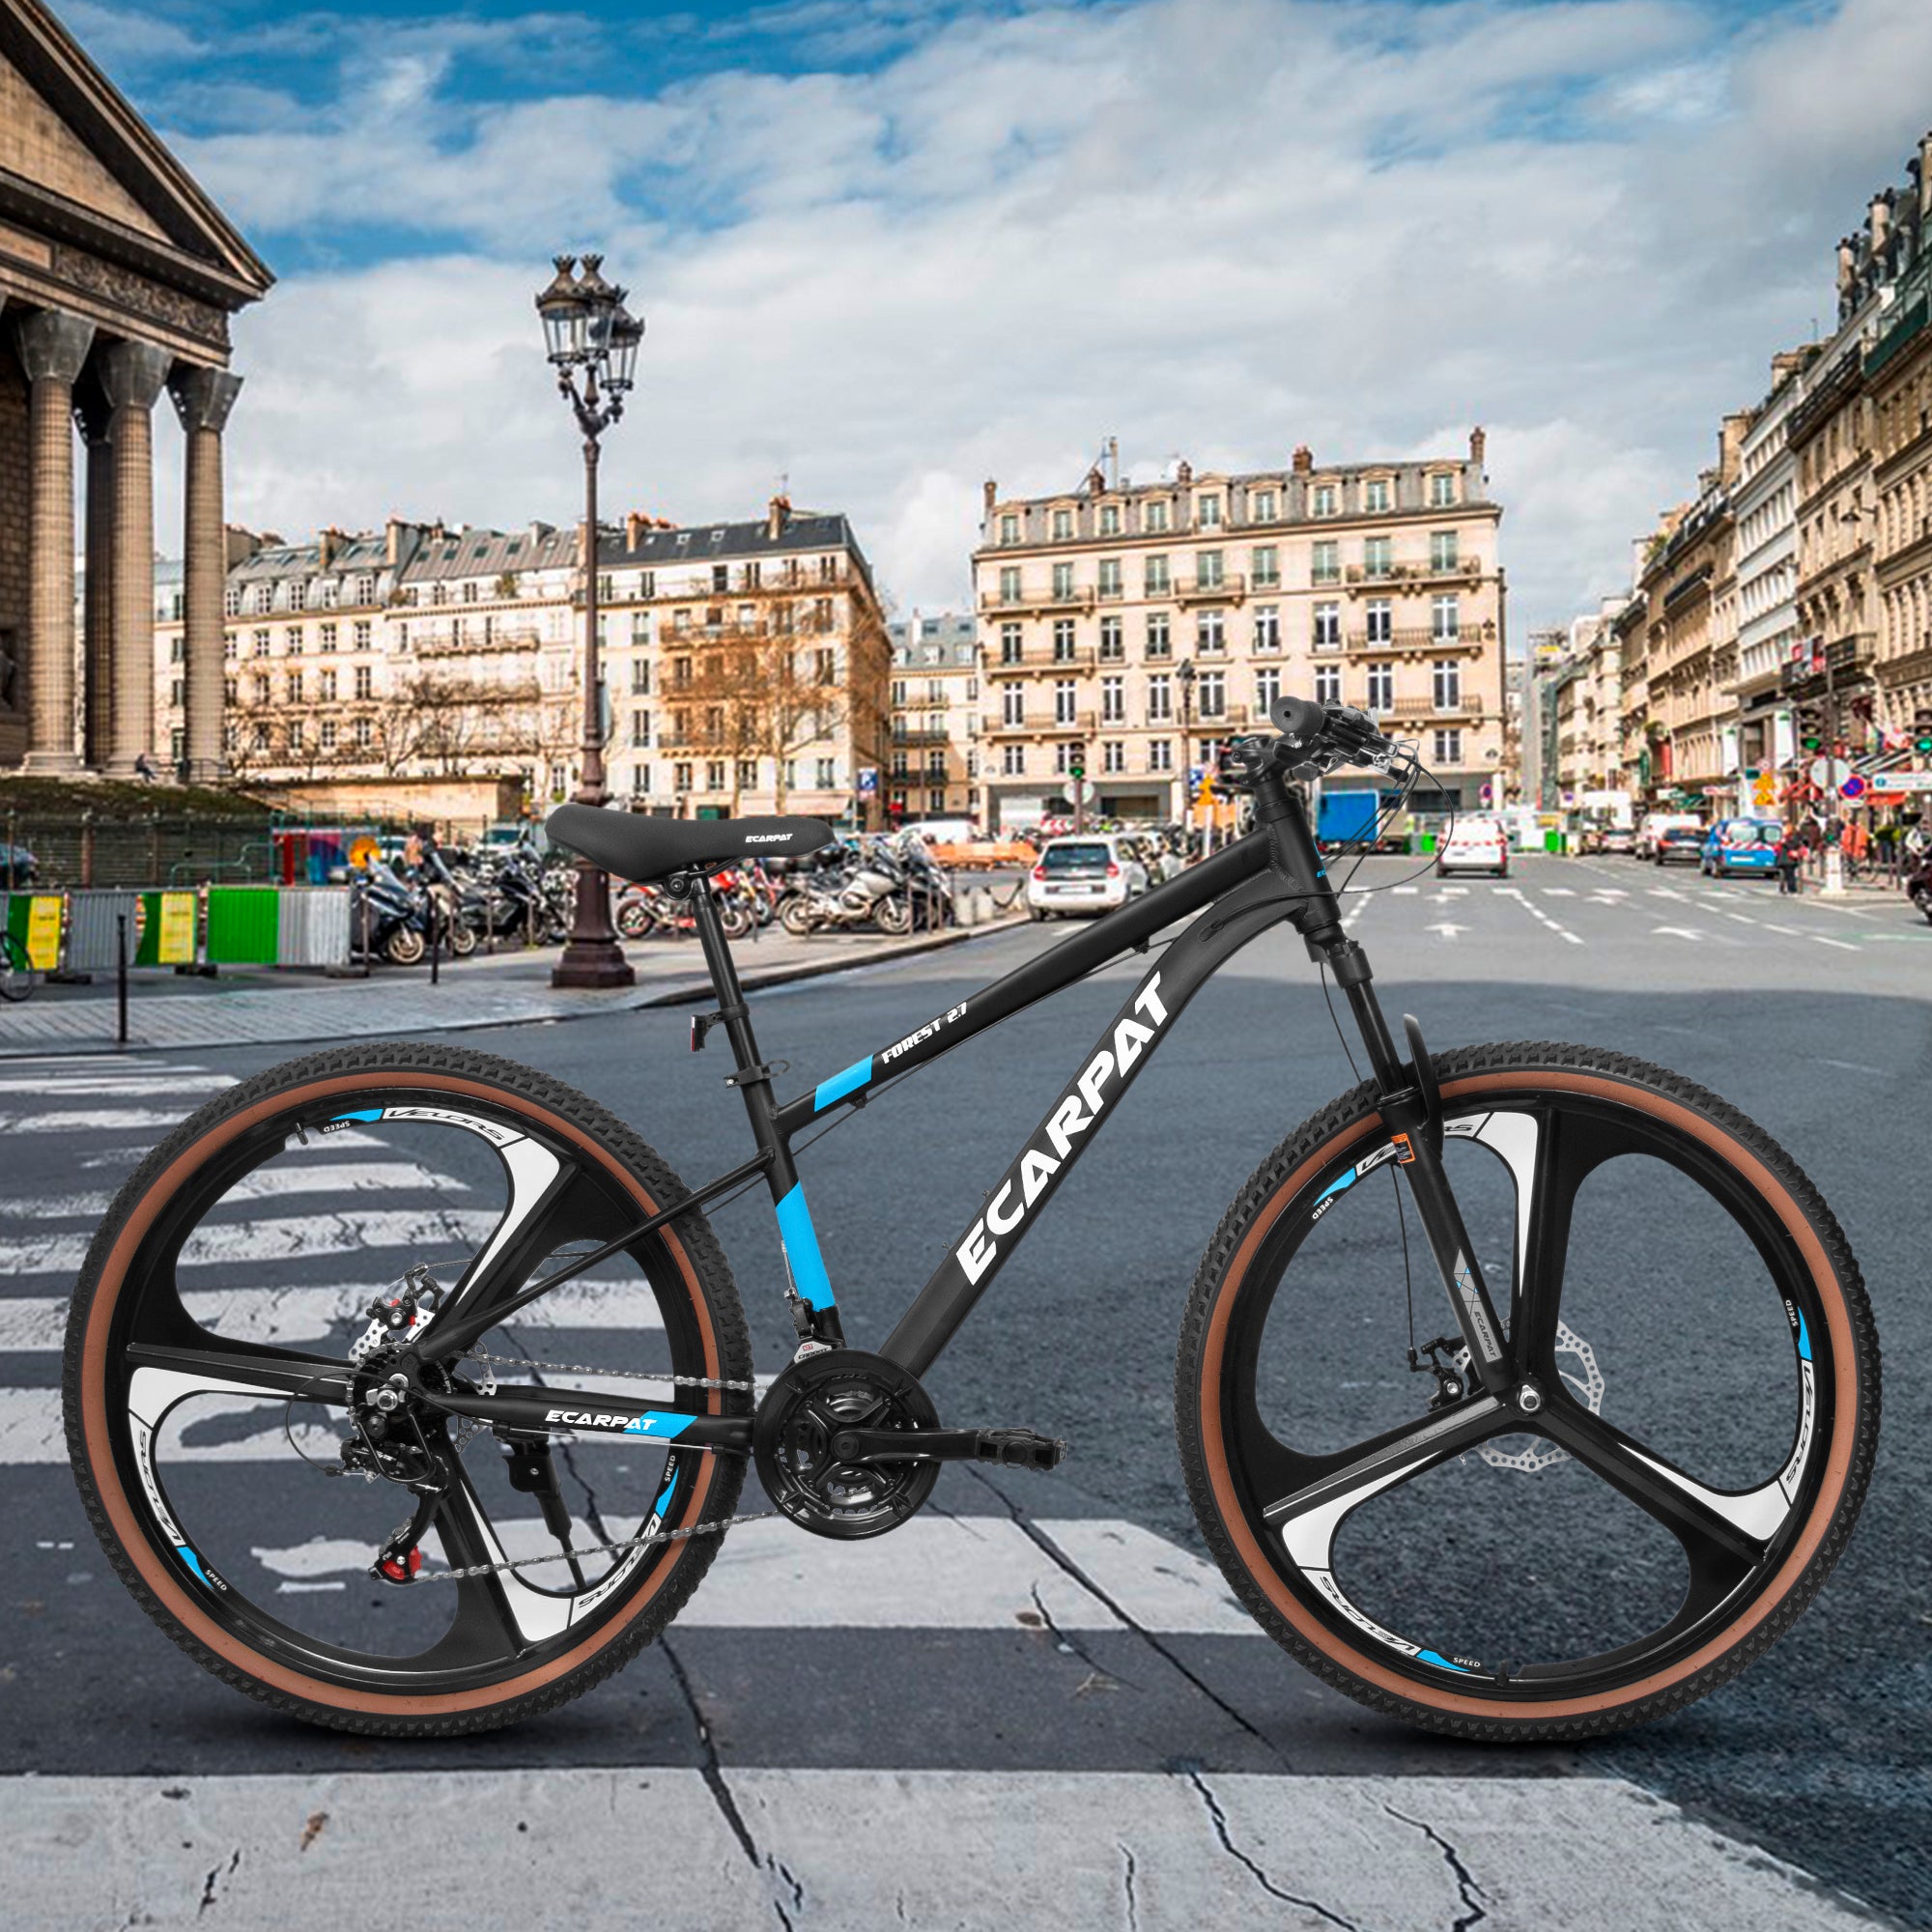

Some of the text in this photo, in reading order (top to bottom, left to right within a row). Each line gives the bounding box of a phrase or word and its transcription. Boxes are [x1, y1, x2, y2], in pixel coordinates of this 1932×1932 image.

[745, 834, 793, 842] ECARPAT
[881, 1017, 941, 1065] FOREST
[323, 1121, 351, 1133] SPEED
[955, 971, 1168, 1286] ECARPAT
[1312, 1196, 1334, 1220] SPEED
[1785, 1299, 1799, 1327] SPEED
[1474, 1311, 1496, 1357] ECARPAT
[545, 1409, 658, 1431] ECARPAT
[664, 1454, 677, 1483] SPEED
[205, 1569, 227, 1592] SPEED
[1453, 1657, 1481, 1668] SPEED
